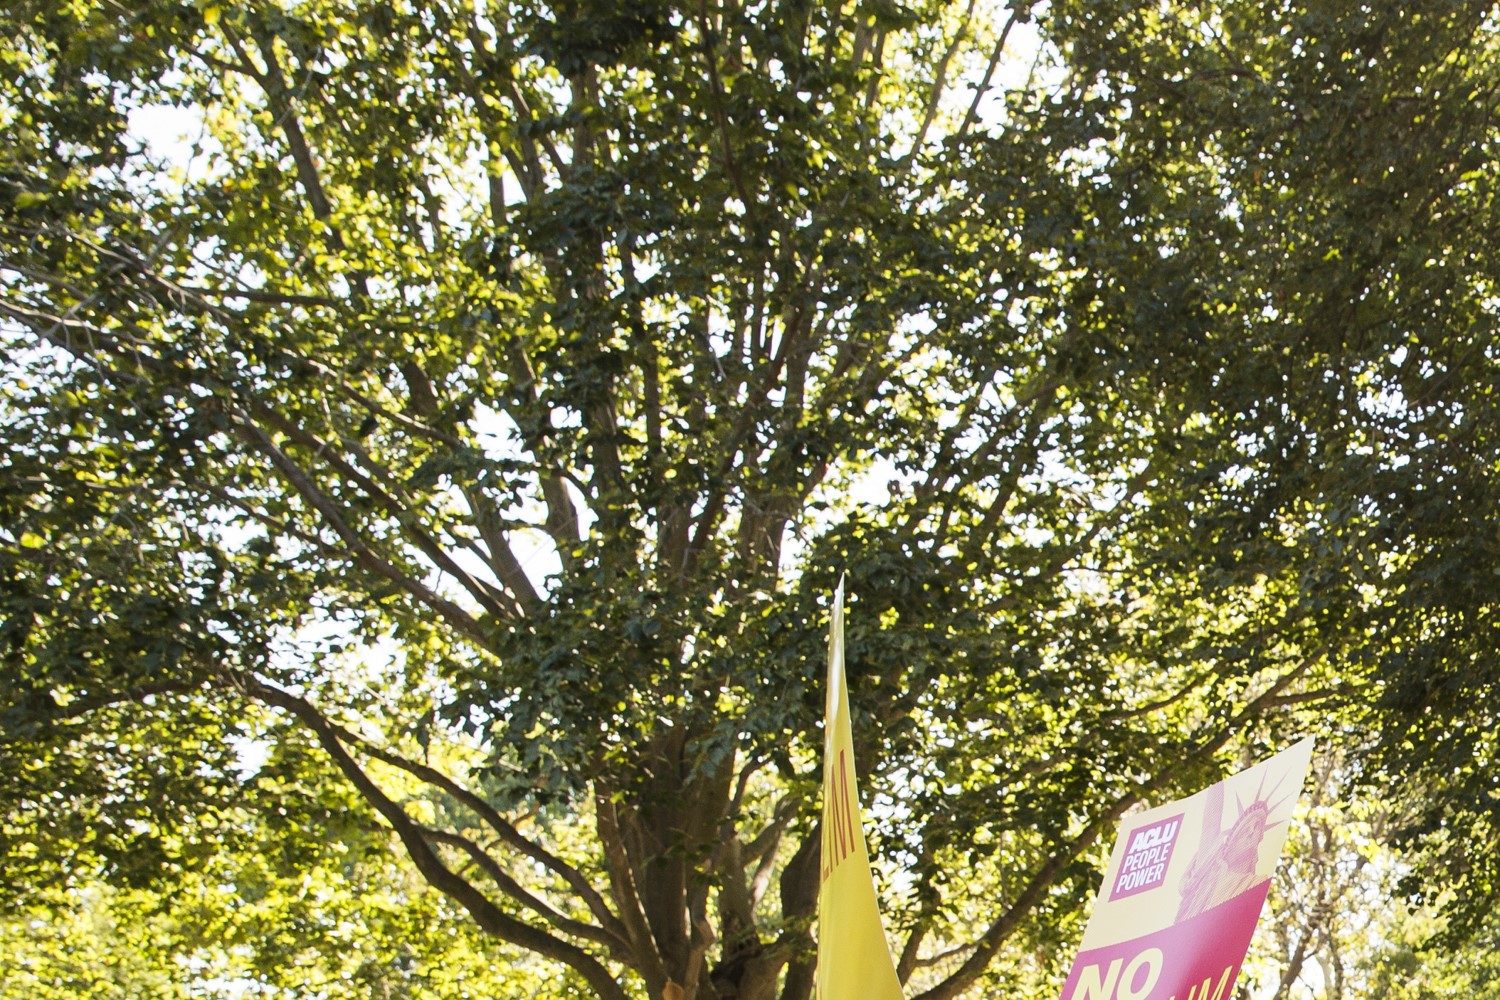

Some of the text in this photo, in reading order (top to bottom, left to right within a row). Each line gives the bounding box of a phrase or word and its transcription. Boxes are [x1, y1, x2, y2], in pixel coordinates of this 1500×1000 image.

[1129, 820, 1178, 855] ACLU
[1122, 842, 1172, 871] PEOPLE
[1116, 862, 1166, 894] POWER
